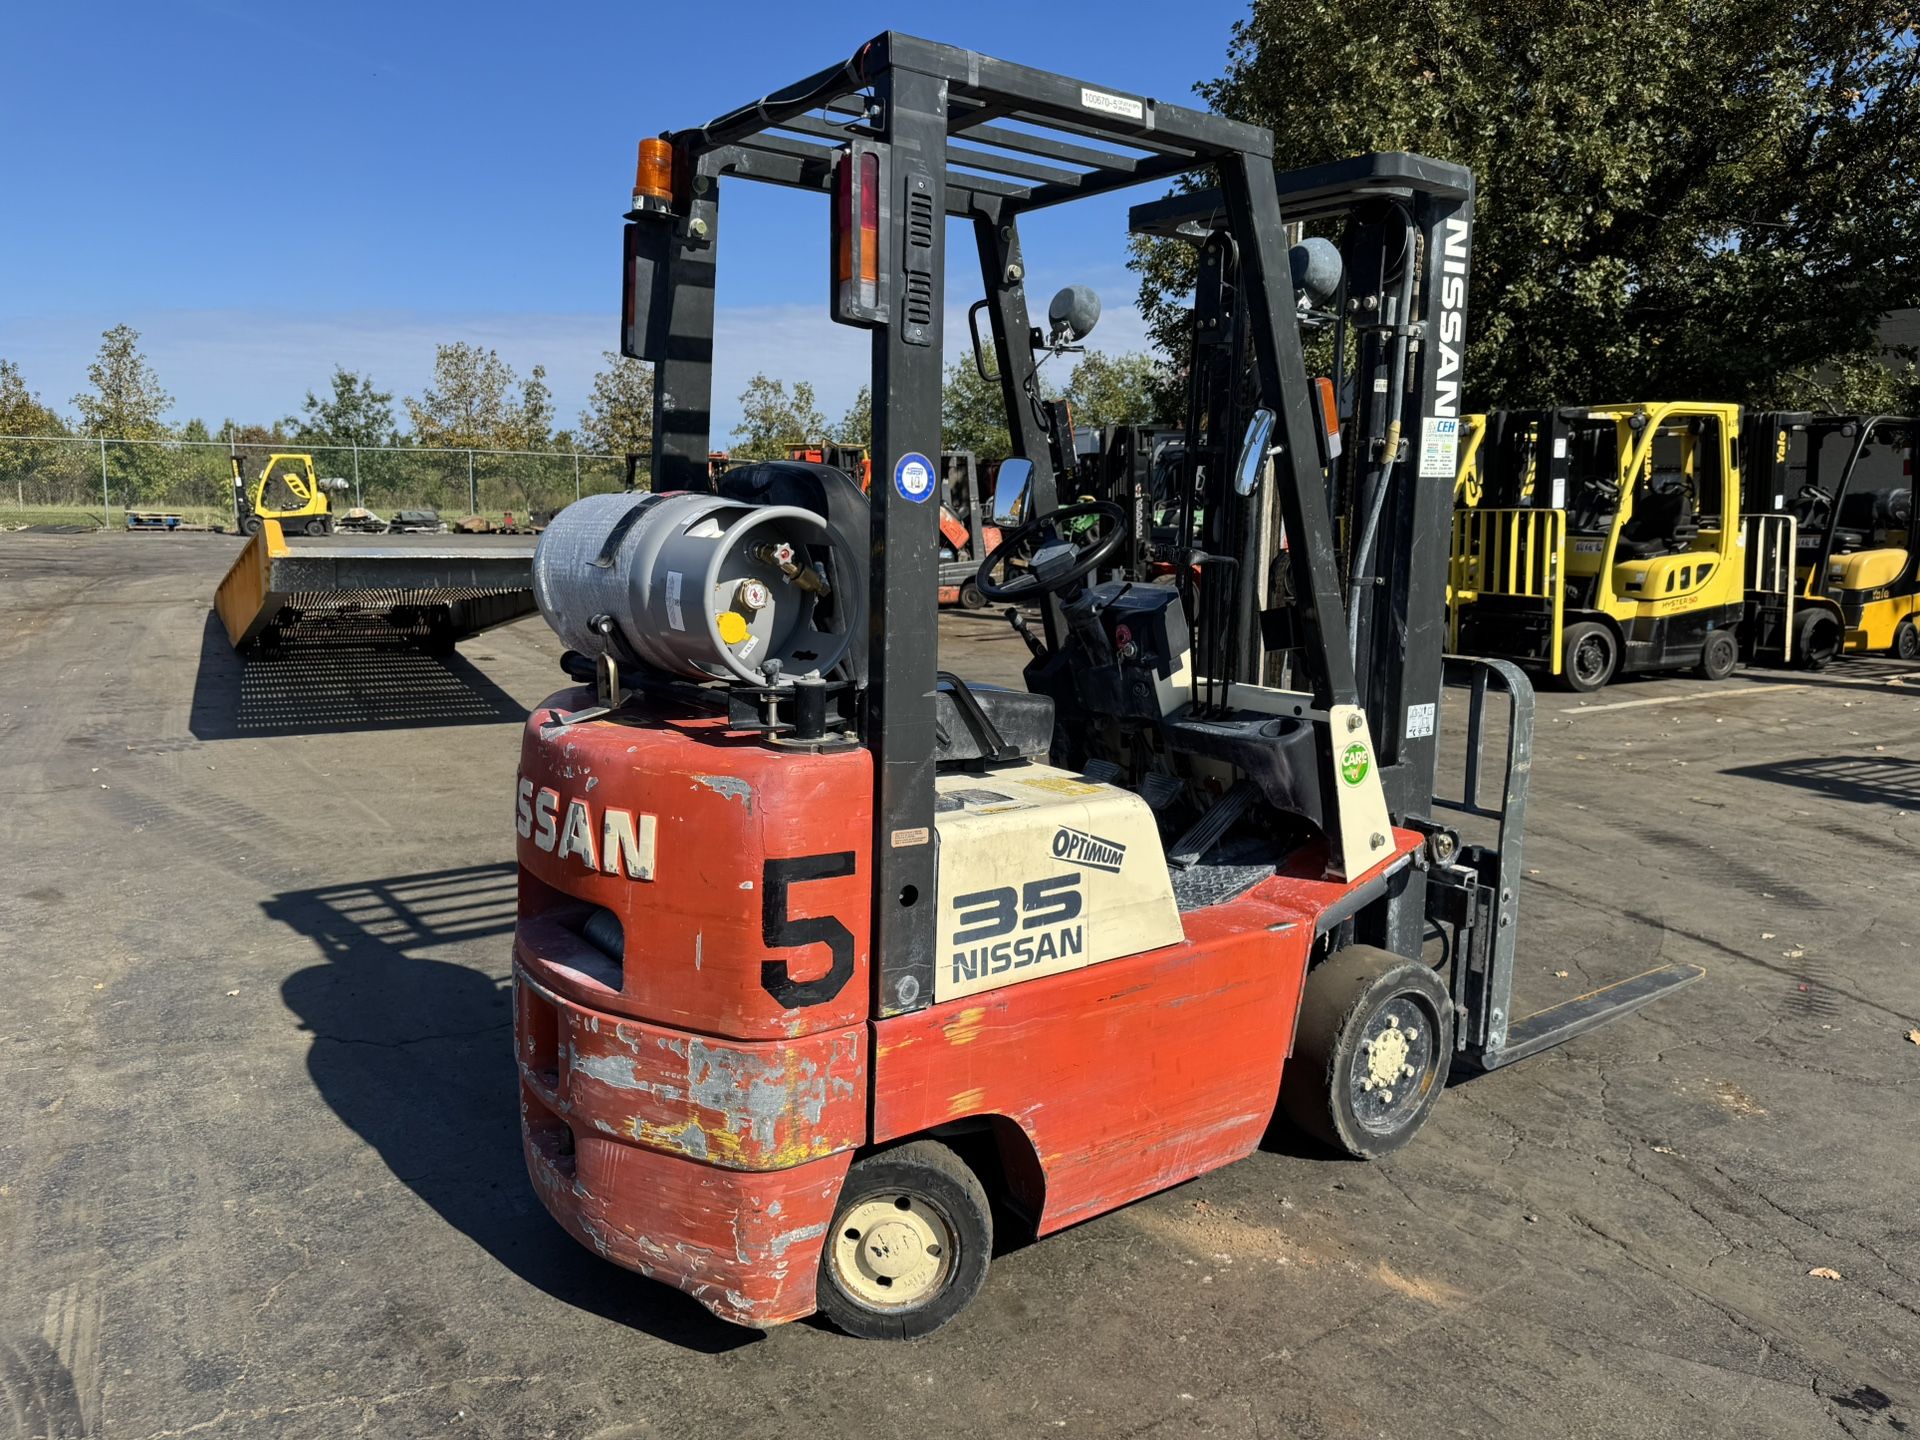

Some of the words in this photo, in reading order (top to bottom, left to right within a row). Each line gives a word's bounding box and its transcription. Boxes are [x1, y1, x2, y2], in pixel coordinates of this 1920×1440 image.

[1434, 218, 1468, 417] NISSAN
[1437, 421, 1456, 433] CEH
[1776, 430, 1786, 464] Yale
[1662, 598, 1688, 608] HYSTER
[1053, 829, 1124, 866] OPTIMUM
[761, 850, 856, 1010] 5
[953, 872, 1083, 946] 35
[952, 925, 1083, 984] NISSAN
